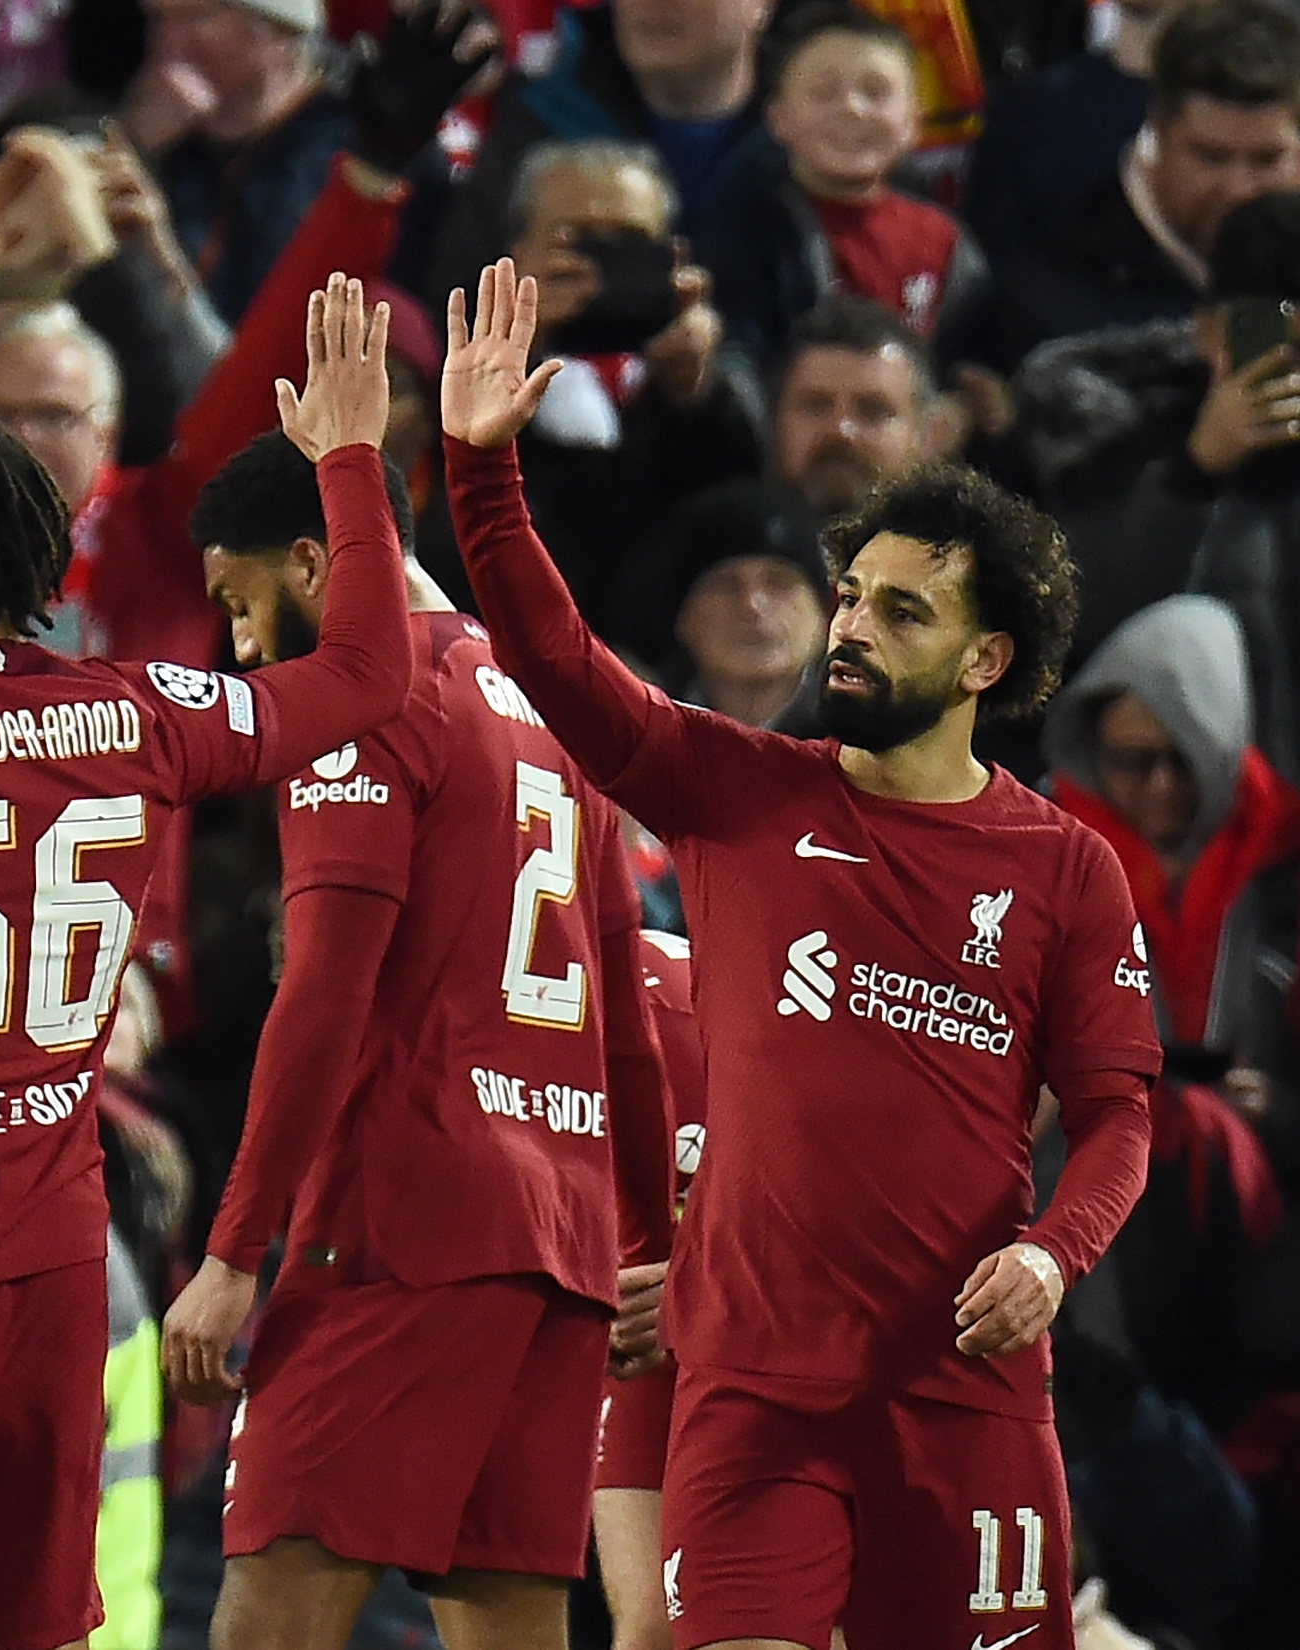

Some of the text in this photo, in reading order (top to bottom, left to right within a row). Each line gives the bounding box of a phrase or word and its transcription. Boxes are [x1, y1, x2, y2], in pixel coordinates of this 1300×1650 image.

[289, 774, 389, 812] Expedia
[501, 760, 586, 1032] 2
[961, 944, 1001, 969] LFC
[849, 991, 1014, 1056] chartered
[471, 1067, 530, 1121] SIDE
[545, 1084, 606, 1137] SIDE
[969, 1507, 1048, 1613] 11
